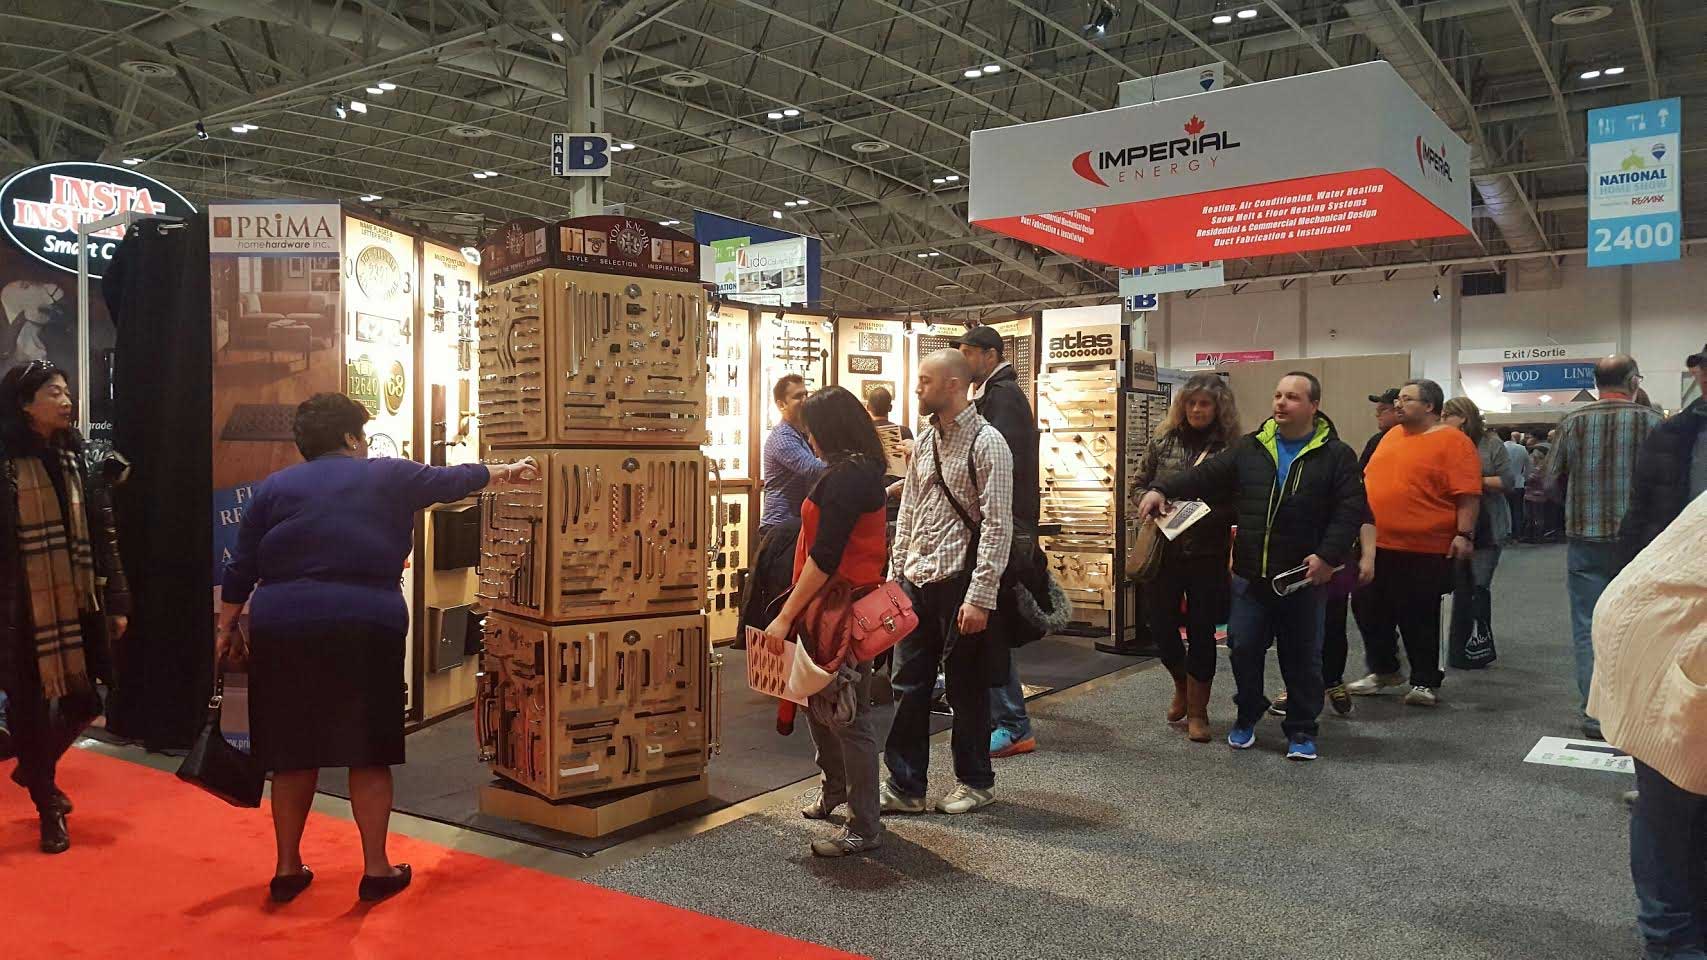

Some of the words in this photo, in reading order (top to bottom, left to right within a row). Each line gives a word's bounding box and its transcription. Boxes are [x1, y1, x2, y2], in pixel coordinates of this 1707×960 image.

[554, 134, 563, 175] HALL
[569, 136, 608, 170] B
[1119, 156, 1219, 183] ENERGY
[1600, 169, 1667, 186] NATIONAL
[49, 174, 166, 215] INSTA-
[1239, 201, 1252, 211] Air
[1317, 189, 1345, 200] Water
[1347, 184, 1384, 196] Heating
[1601, 184, 1630, 195] HOME
[1633, 180, 1667, 192] SHOW
[1632, 194, 1665, 206] RE/MAX
[1196, 226, 1240, 238] Residential
[1241, 224, 1247, 232] &
[1248, 218, 1297, 232] Commercial
[1298, 212, 1347, 226] Mechanical
[1347, 208, 1377, 219] Design
[1211, 214, 1234, 225] Snow
[1236, 211, 1256, 222] Melt
[1257, 210, 1263, 219] &
[1265, 207, 1288, 218] Floor
[1290, 202, 1325, 215] Heating
[1328, 197, 1367, 211] Systems
[609, 223, 621, 244] TOP
[625, 220, 649, 249] KNOBS
[1214, 235, 1234, 247] Duct
[1236, 230, 1286, 245] Fabrication
[1288, 230, 1294, 238] &
[1297, 223, 1352, 238] Installation
[1594, 222, 1674, 253] 2400
[567, 255, 588, 263] STYLE
[600, 258, 637, 268] SELECTION
[647, 263, 689, 273] INSPIRATION
[1049, 330, 1113, 350] atlas
[1134, 360, 1154, 376] atlas
